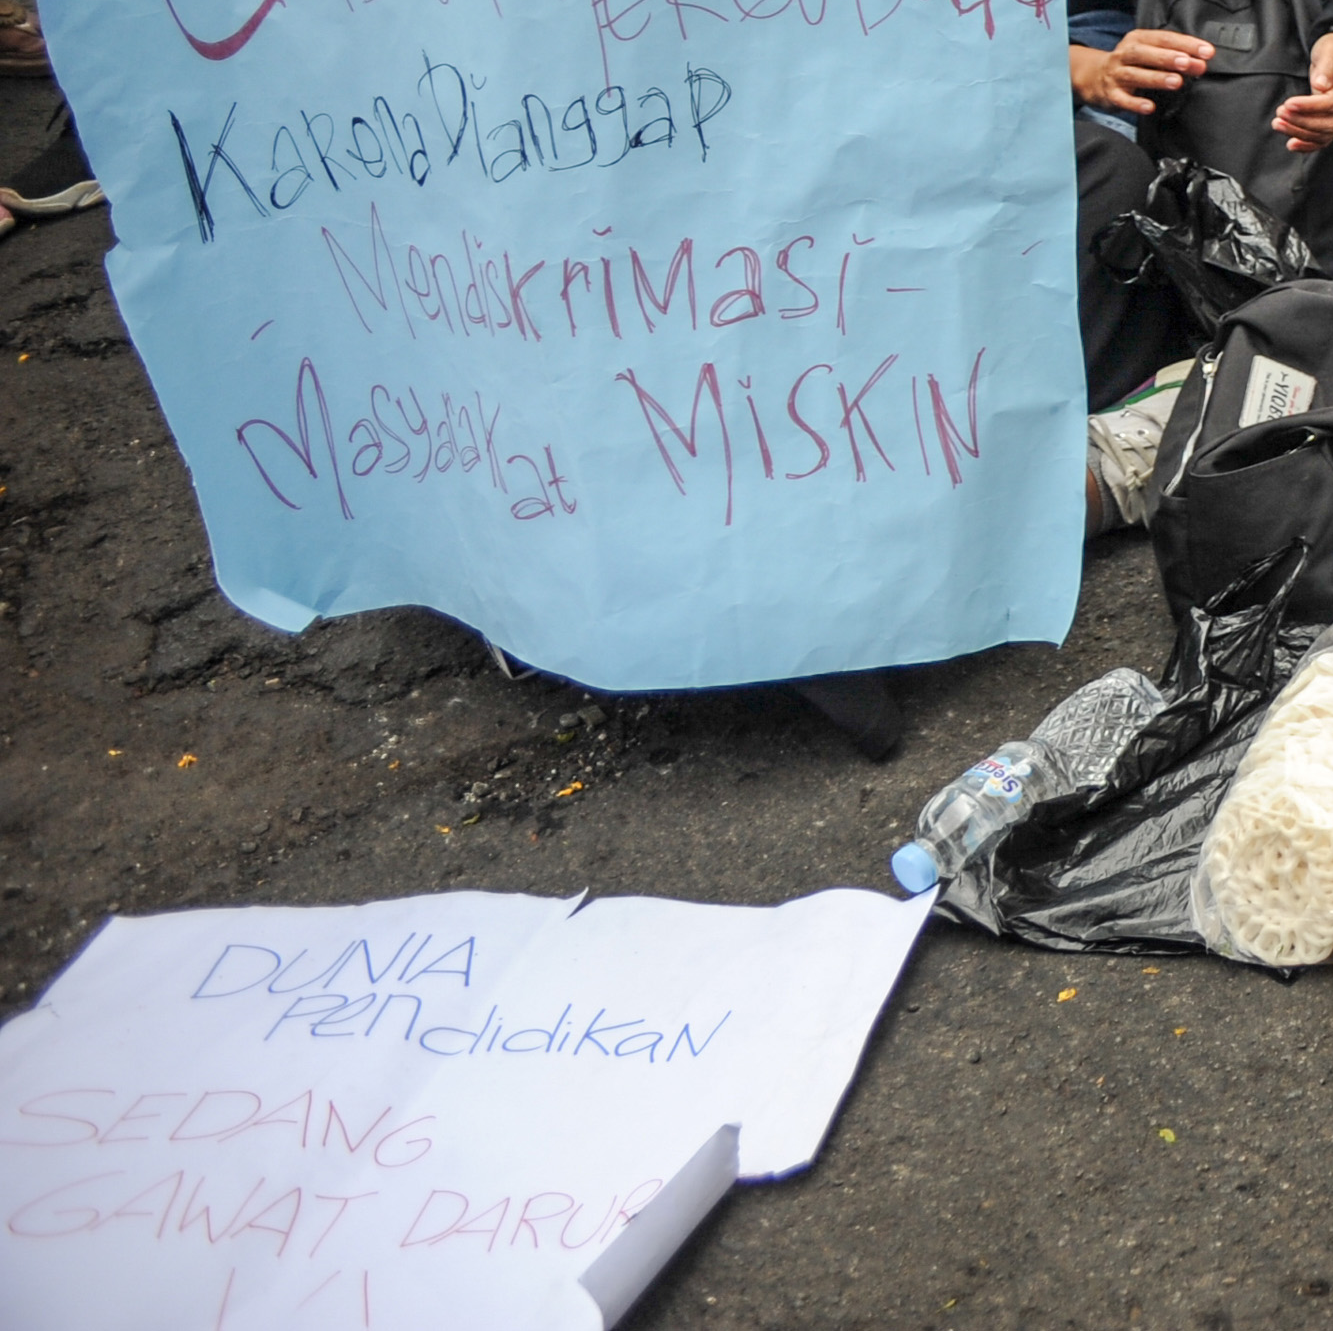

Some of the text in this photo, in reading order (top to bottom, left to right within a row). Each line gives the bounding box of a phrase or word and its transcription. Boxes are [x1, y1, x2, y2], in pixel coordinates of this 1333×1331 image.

[191, 932, 476, 1000] DUNIA
[0, 1089, 436, 1168] SEDANG
[7, 1170, 379, 1258] GAWAT
